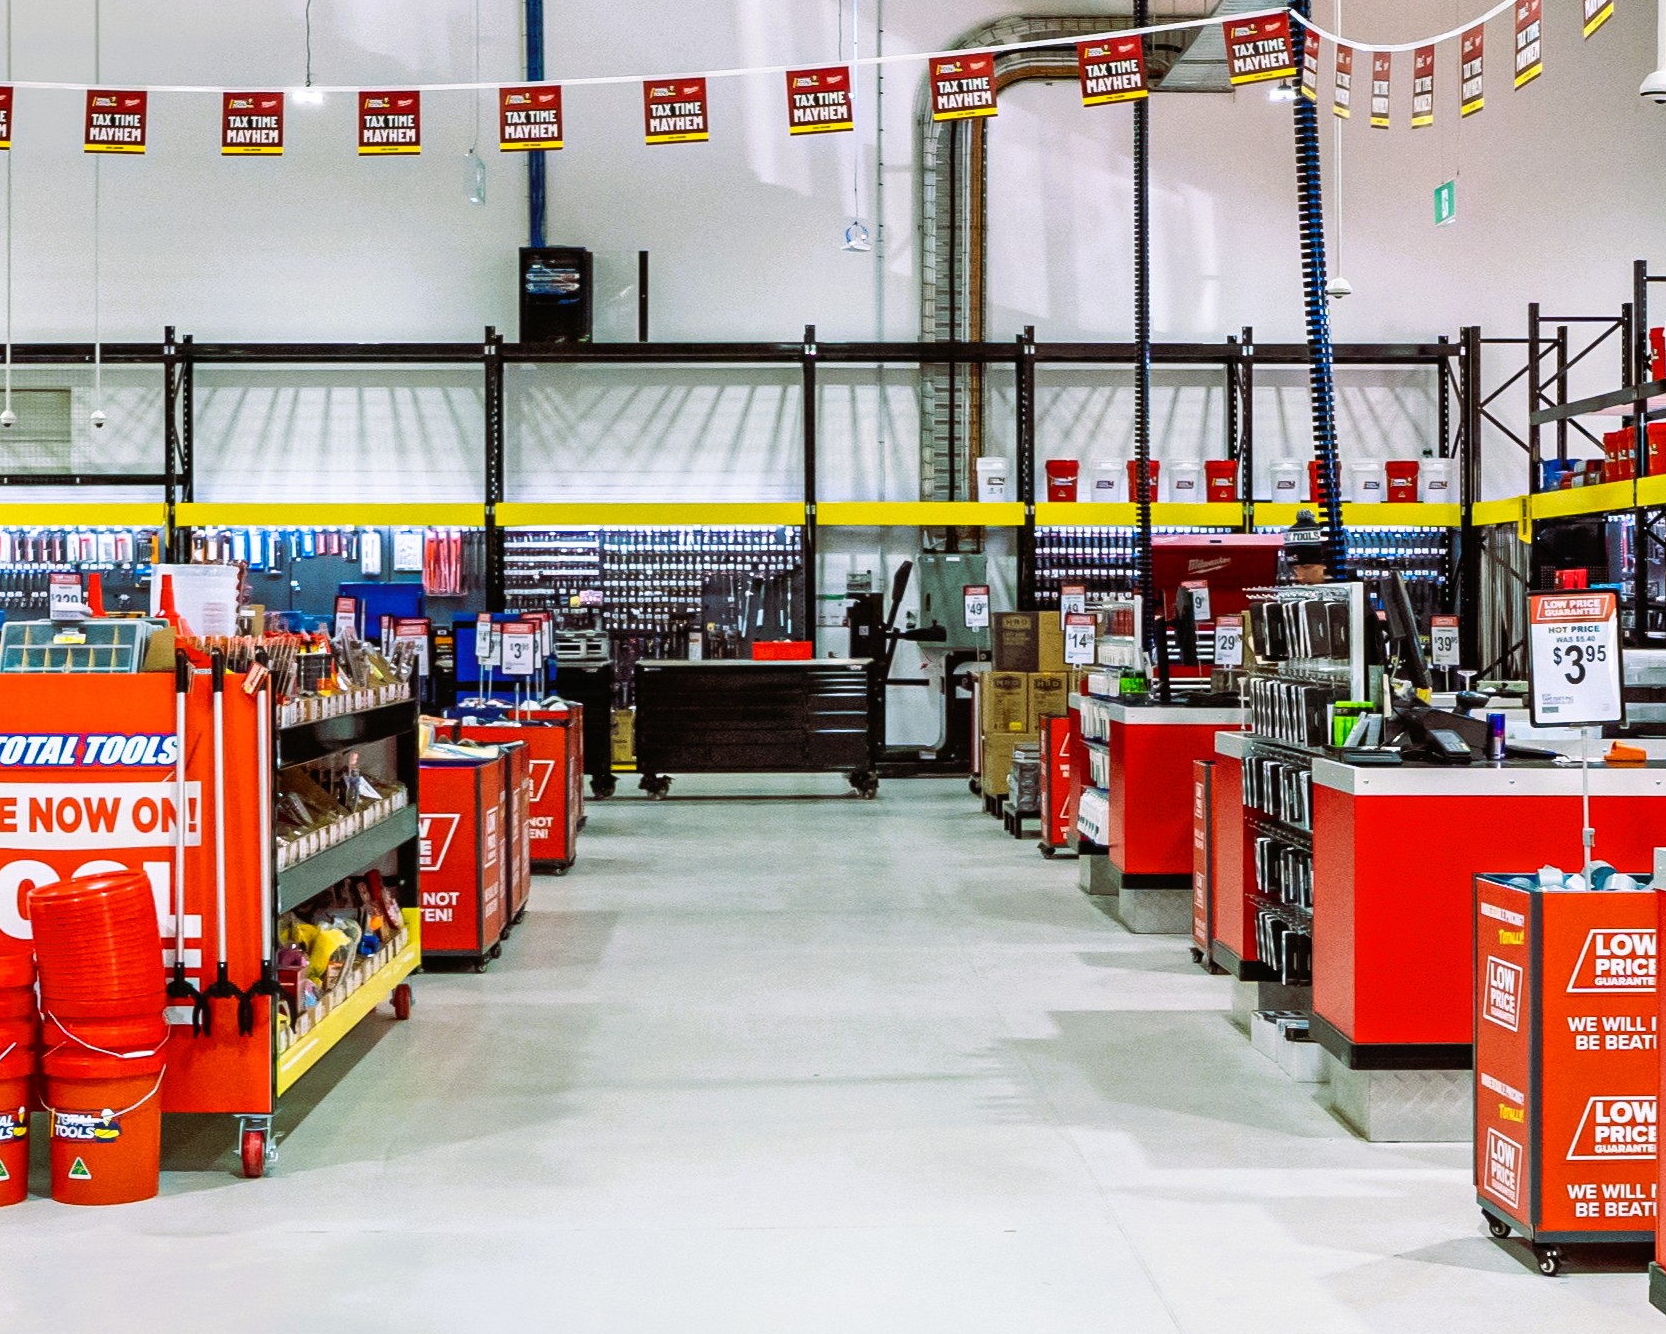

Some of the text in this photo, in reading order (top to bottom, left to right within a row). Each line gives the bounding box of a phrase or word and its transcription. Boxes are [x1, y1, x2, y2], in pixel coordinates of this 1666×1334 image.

[1232, 37, 1287, 59] TAX TIME
[1233, 50, 1290, 72] MAYHEM
[650, 102, 702, 118] TAX TIME
[650, 115, 703, 132] MAYHEM
[1187, 557, 1231, 572] Milwaukee
[1544, 598, 1601, 610] LOW PRICE
[1544, 608, 1601, 617] GUARANTEE
[1548, 625, 1600, 634] HOT PRICE
[83, 735, 179, 765] TOOLS
[28, 797, 121, 833] NOW
[422, 892, 460, 906] NOT
[1595, 934, 1656, 956] LOW
[1595, 958, 1656, 975] PRICE
[1490, 967, 1514, 989] LOW
[1490, 986, 1515, 1014] PRICE
[1567, 1017, 1646, 1032] WE WILL
[1575, 1035, 1600, 1050] BE
[55, 1124, 95, 1139] TOOLS
